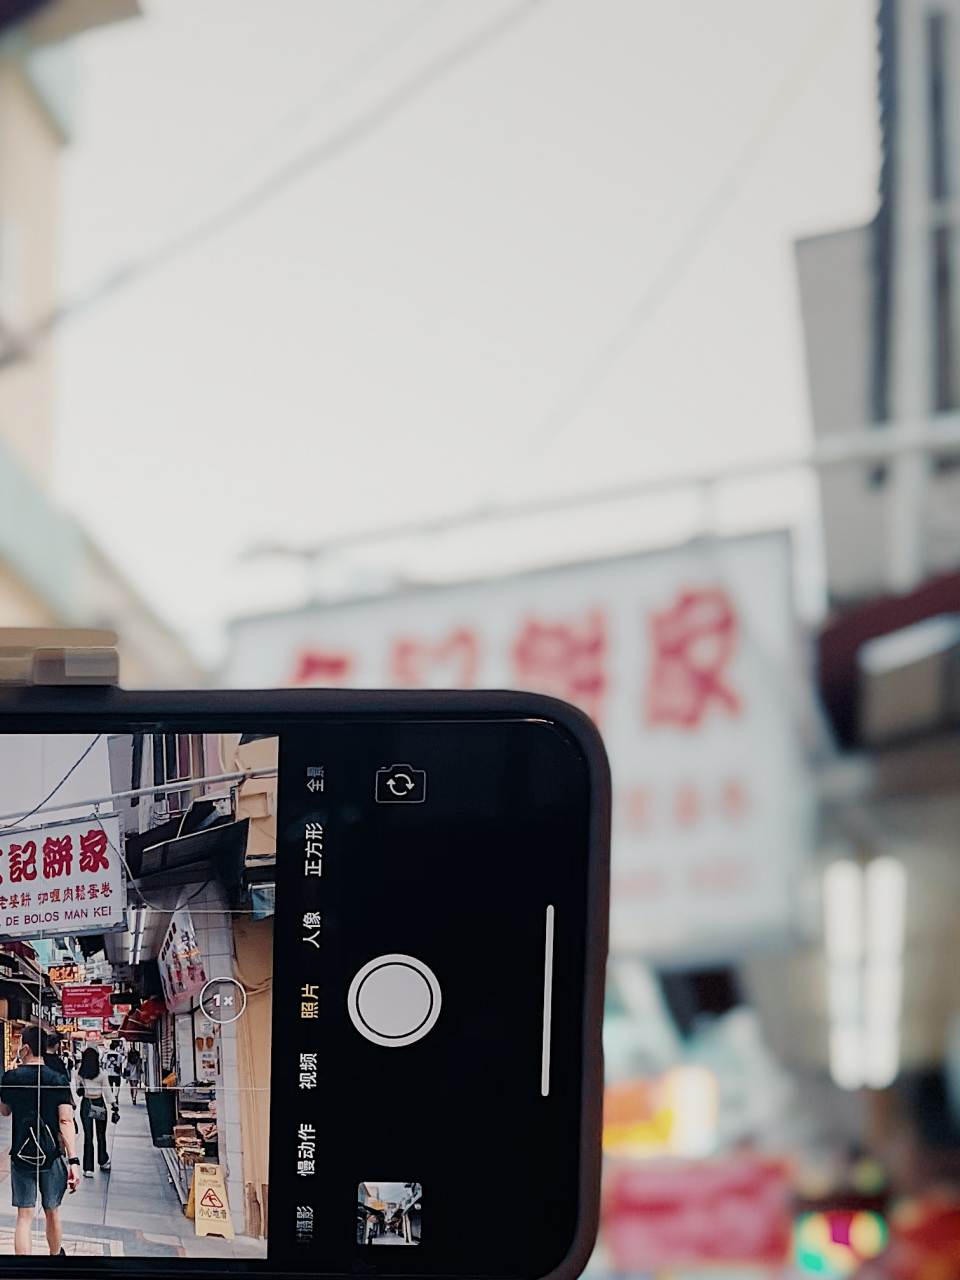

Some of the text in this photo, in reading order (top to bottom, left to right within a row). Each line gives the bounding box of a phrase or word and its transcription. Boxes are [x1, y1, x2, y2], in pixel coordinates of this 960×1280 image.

[304, 822, 324, 877] 正方形
[5, 916, 19, 927] DE
[24, 911, 60, 925] BOLOS
[64, 908, 88, 920] MAN
[93, 905, 112, 918] KEI
[302, 911, 321, 949] 人像
[301, 983, 319, 1018] 照片
[299, 1053, 317, 1089] 视频
[297, 1123, 316, 1176] 慢动作
